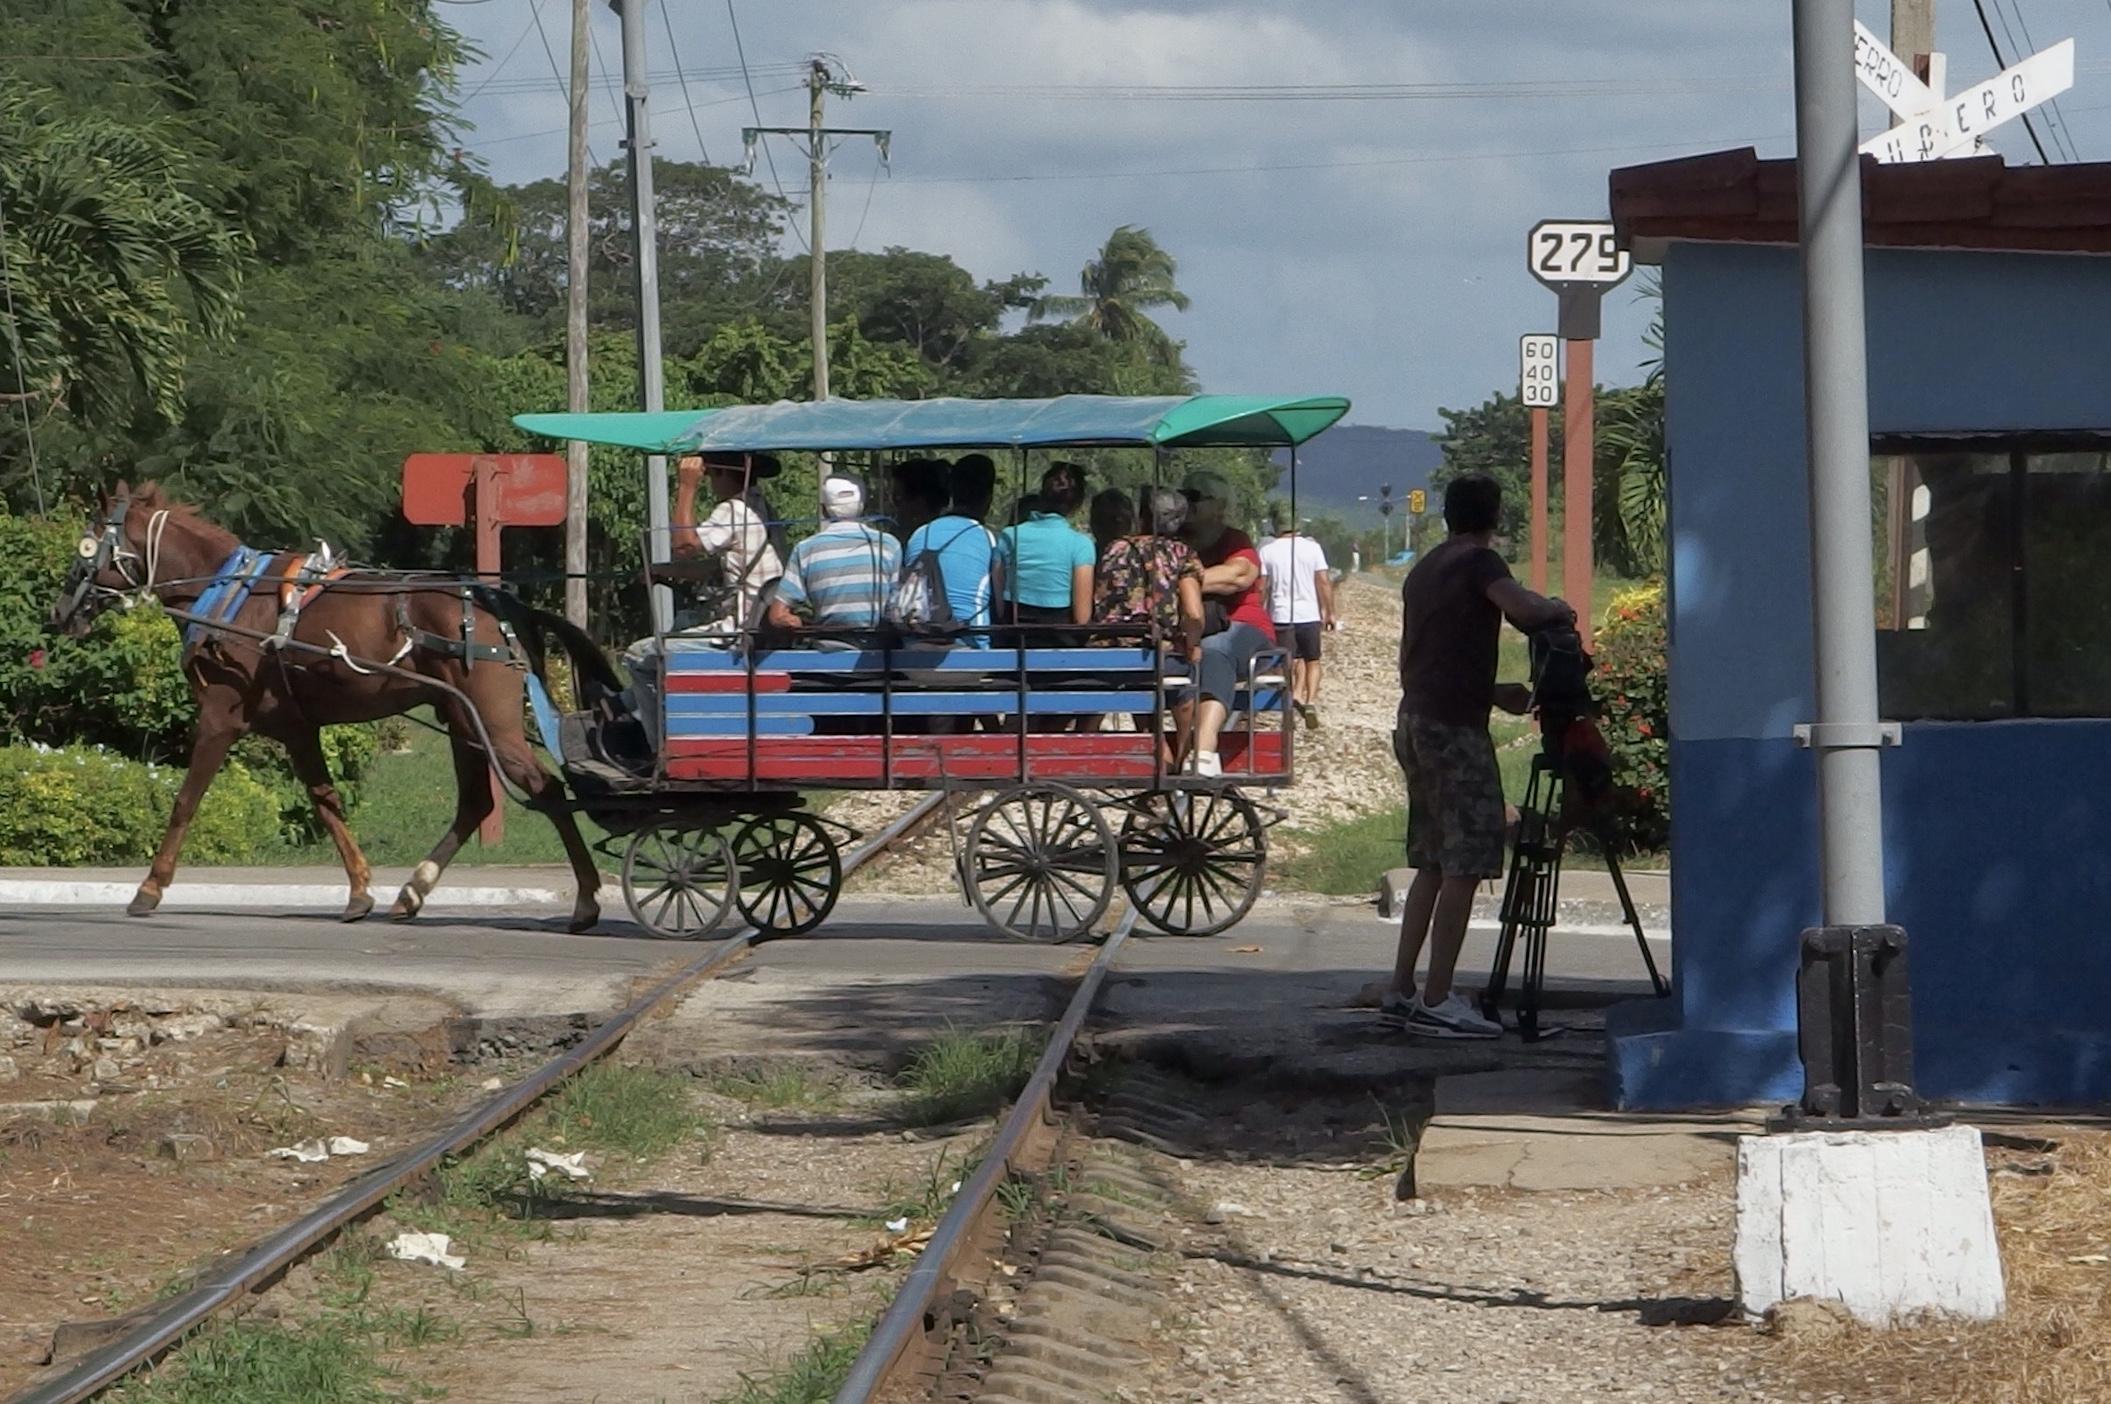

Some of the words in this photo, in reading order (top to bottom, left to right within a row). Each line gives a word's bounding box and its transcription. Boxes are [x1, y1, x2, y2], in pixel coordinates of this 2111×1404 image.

[1854, 32, 1902, 98] ERRO
[1540, 233, 1619, 272] 279
[1526, 342, 1553, 359] 60
[1526, 365, 1552, 381] 40
[1526, 385, 1552, 402] 30
